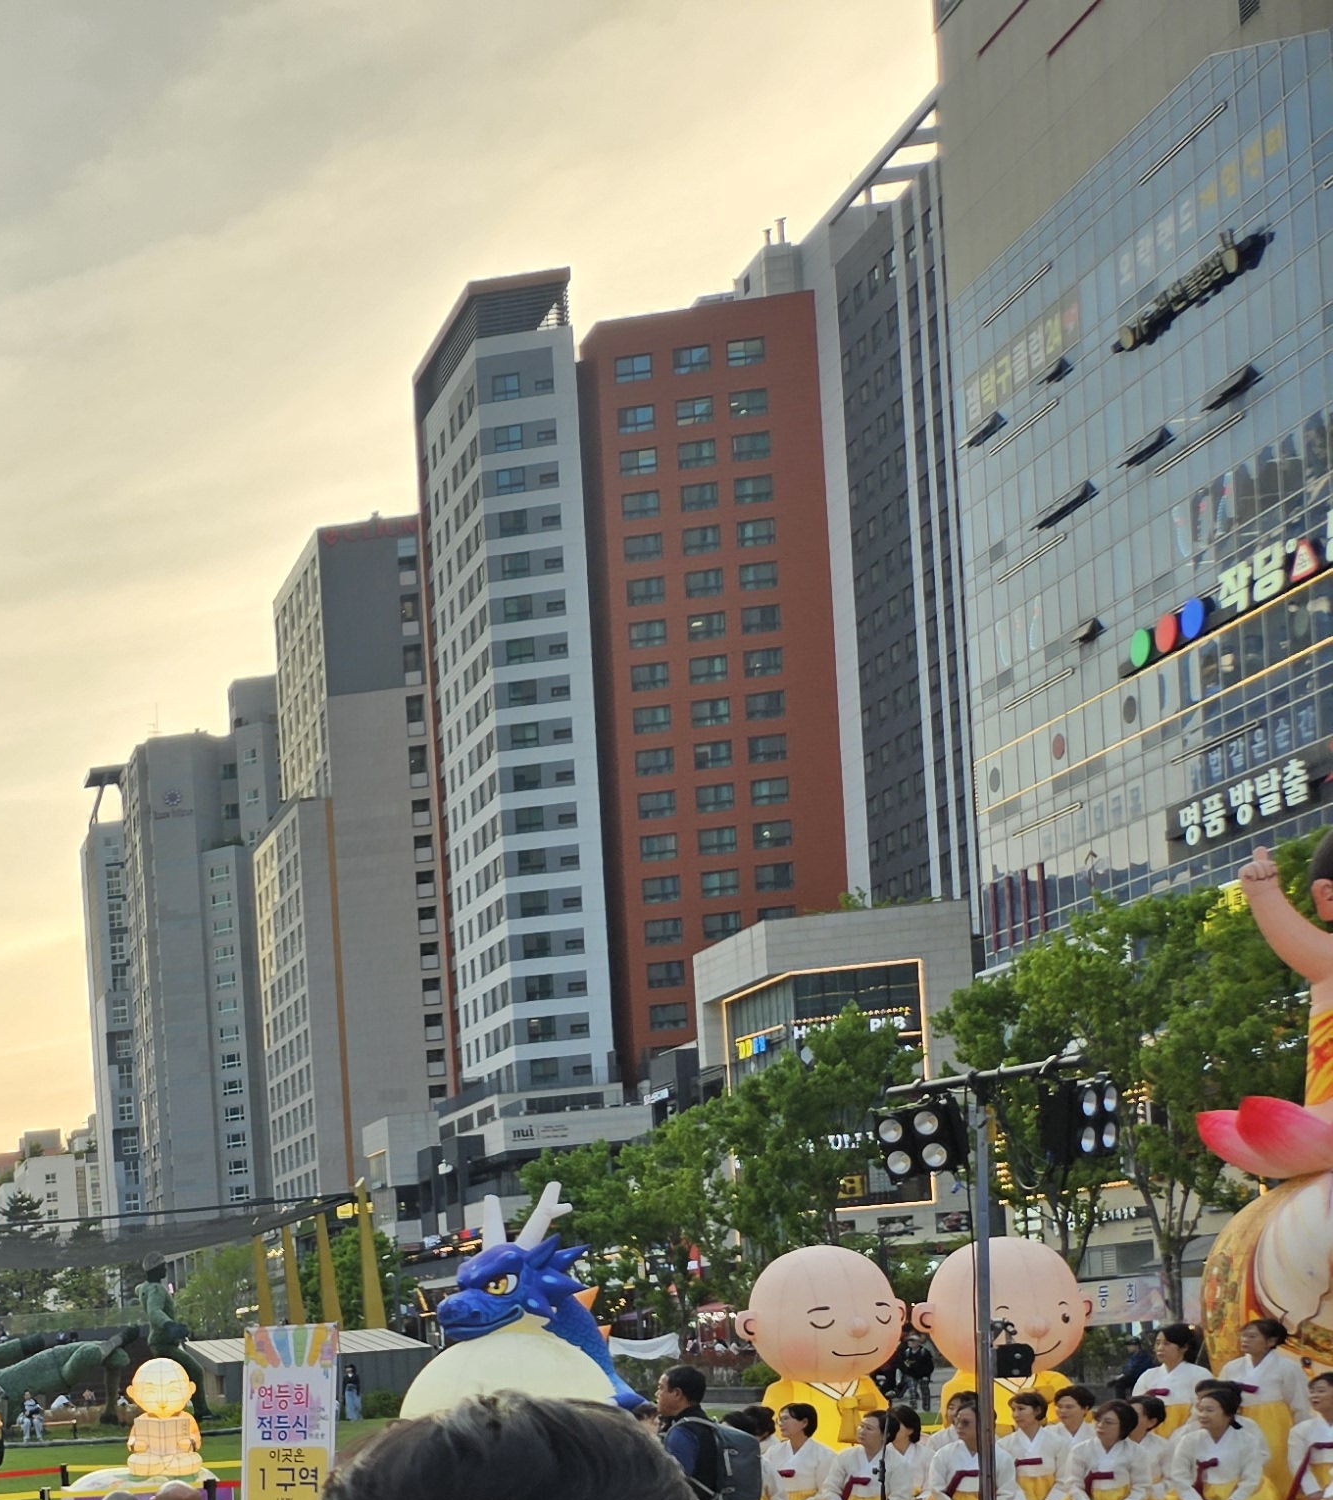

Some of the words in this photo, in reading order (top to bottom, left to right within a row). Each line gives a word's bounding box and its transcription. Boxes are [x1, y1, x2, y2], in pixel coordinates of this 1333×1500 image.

[1178, 793, 1227, 846] 명품
[1228, 758, 1310, 826] 방탈출
[258, 1382, 310, 1411] 연등회
[257, 1415, 309, 1441] 점등식
[269, 1447, 306, 1463] 이곳은
[275, 1466, 319, 1493] 구역
